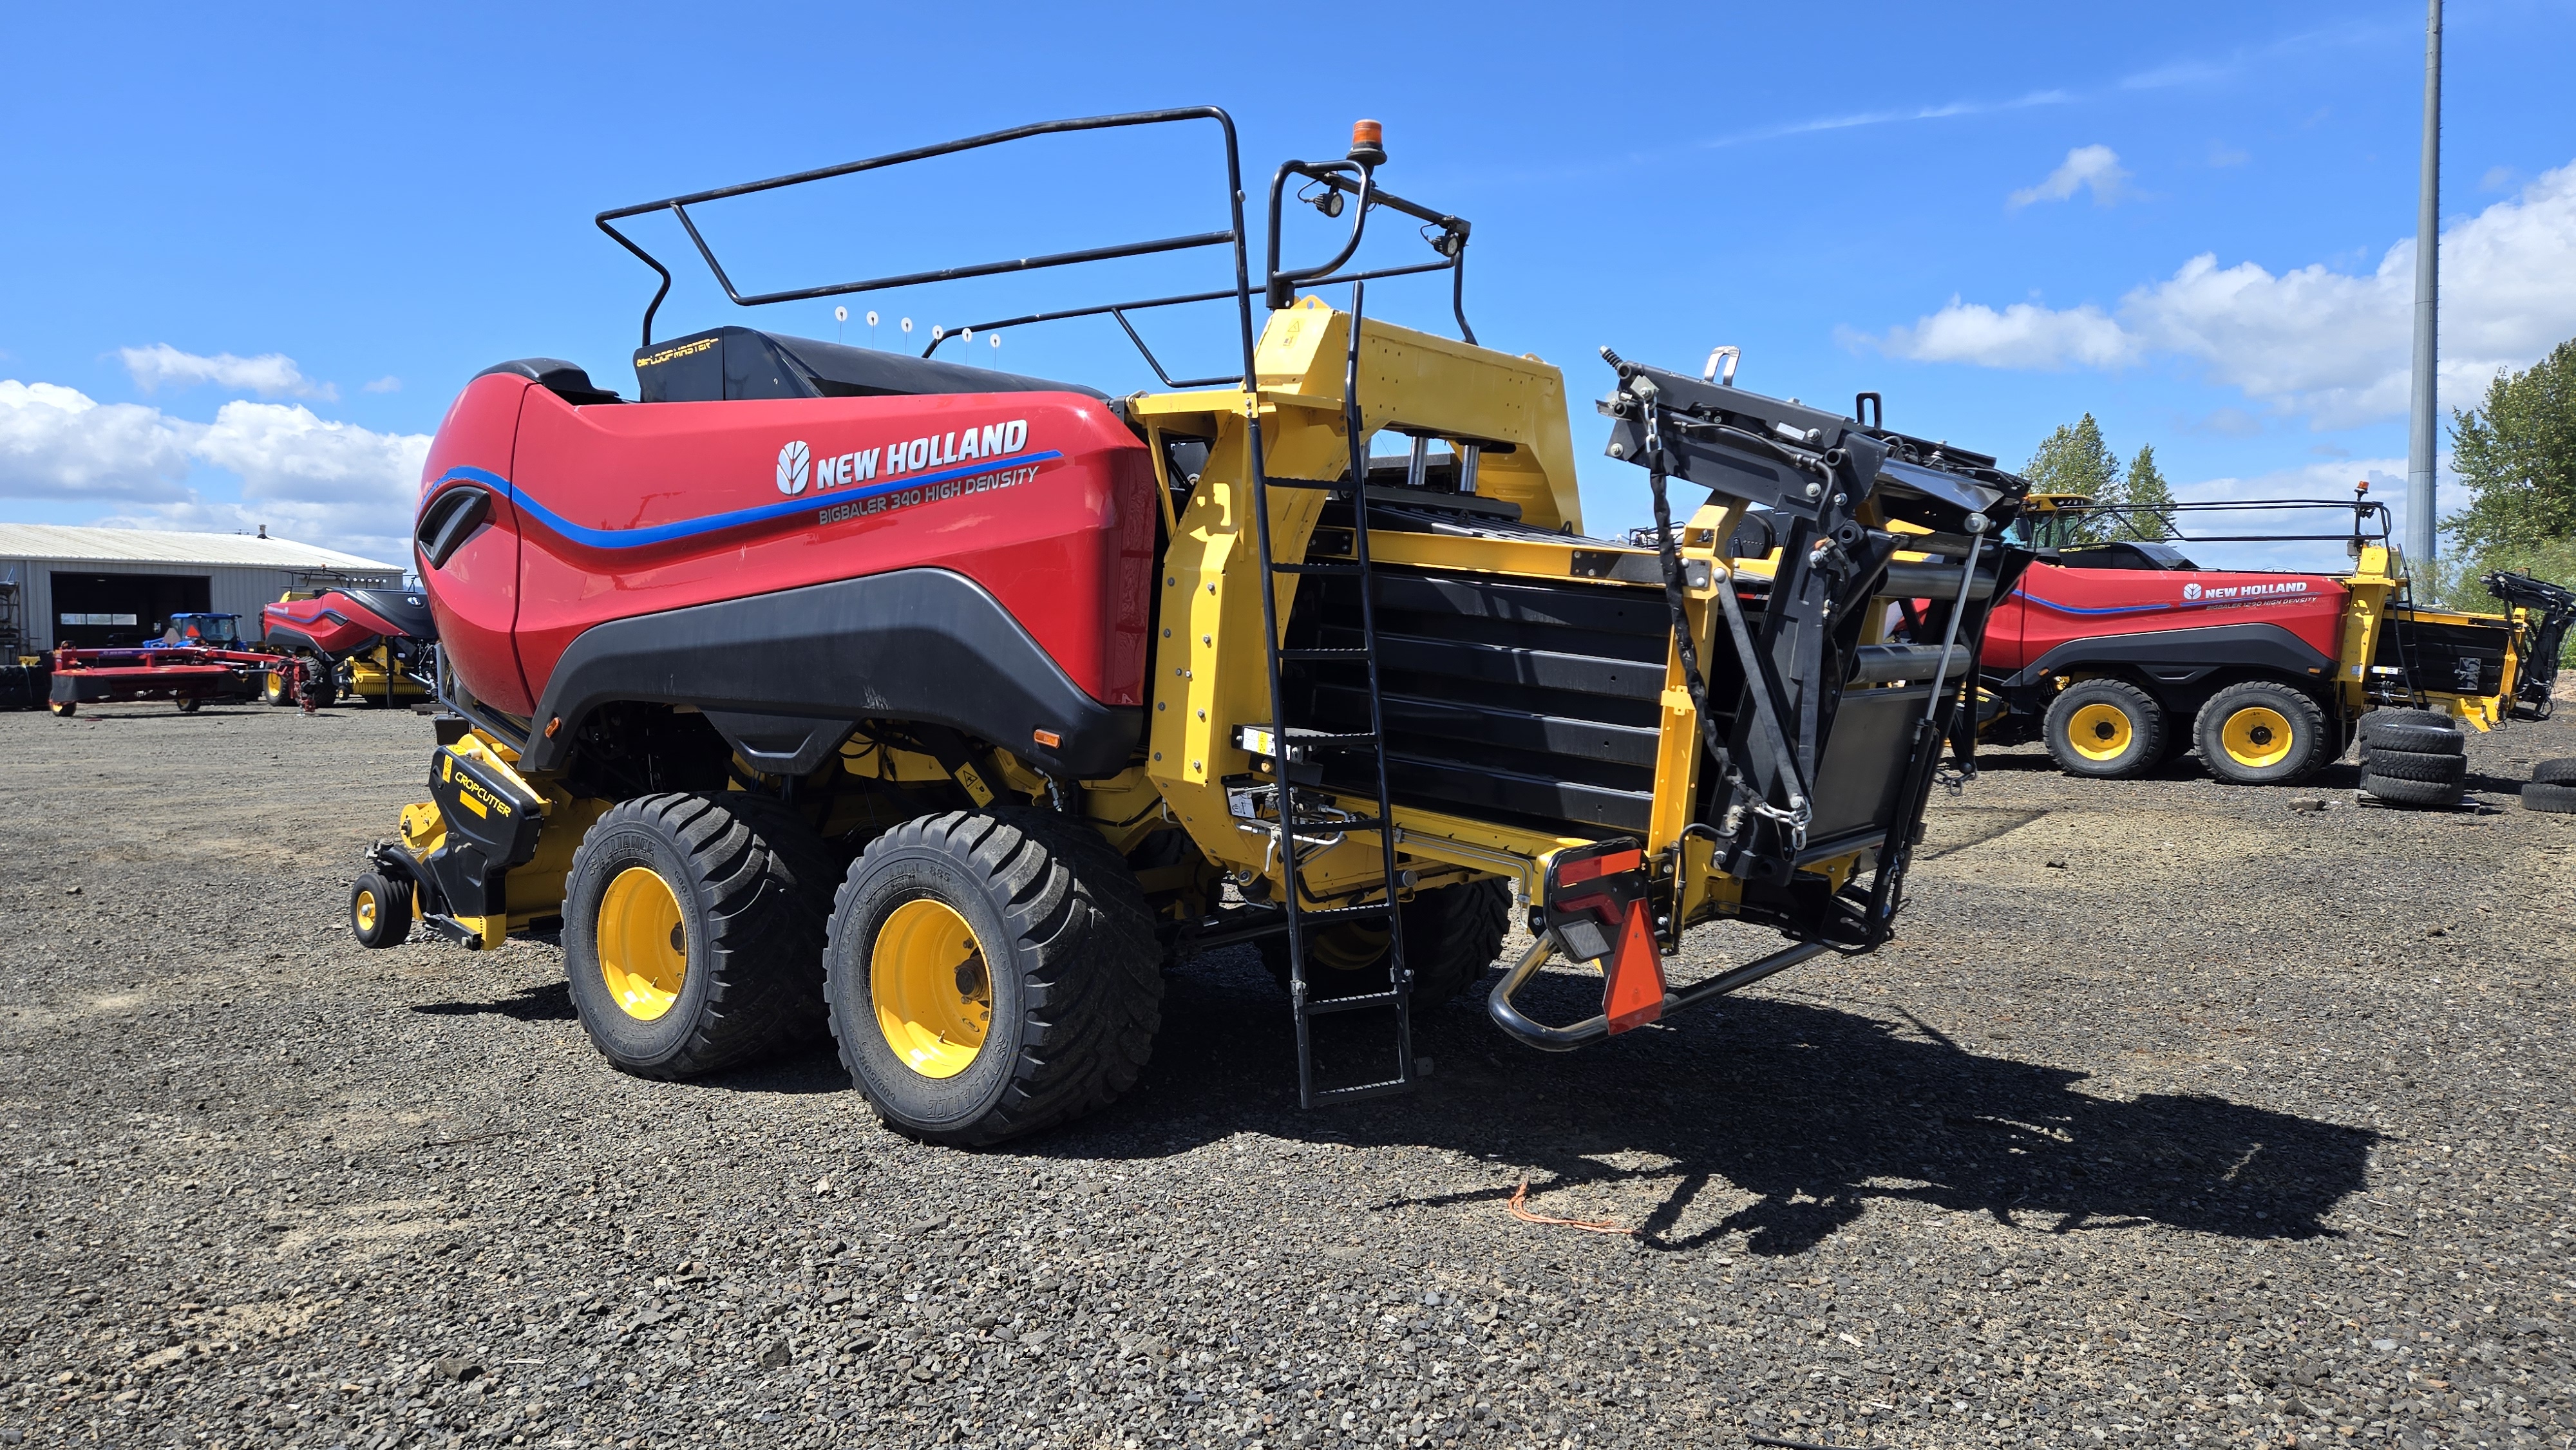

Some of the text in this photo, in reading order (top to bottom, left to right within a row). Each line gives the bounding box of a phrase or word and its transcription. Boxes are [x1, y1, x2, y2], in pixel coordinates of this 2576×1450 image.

[817, 419, 1028, 489] NEW HOLLAND
[819, 466, 1040, 525] BIGBALER 340 HIGH DENSITY
[2205, 582, 2307, 599] NEW HOLLAND
[2206, 602, 2242, 610] BIGBALER
[2282, 596, 2317, 605] DENSITY
[455, 771, 512, 818] CROPCUTTER
[596, 834, 656, 870] ALLIANCE
[880, 863, 923, 881] RADIAL
[929, 865, 951, 883] 885
[606, 1029, 635, 1053] RADIAL
[927, 1049, 1001, 1118] ALLIANCE
